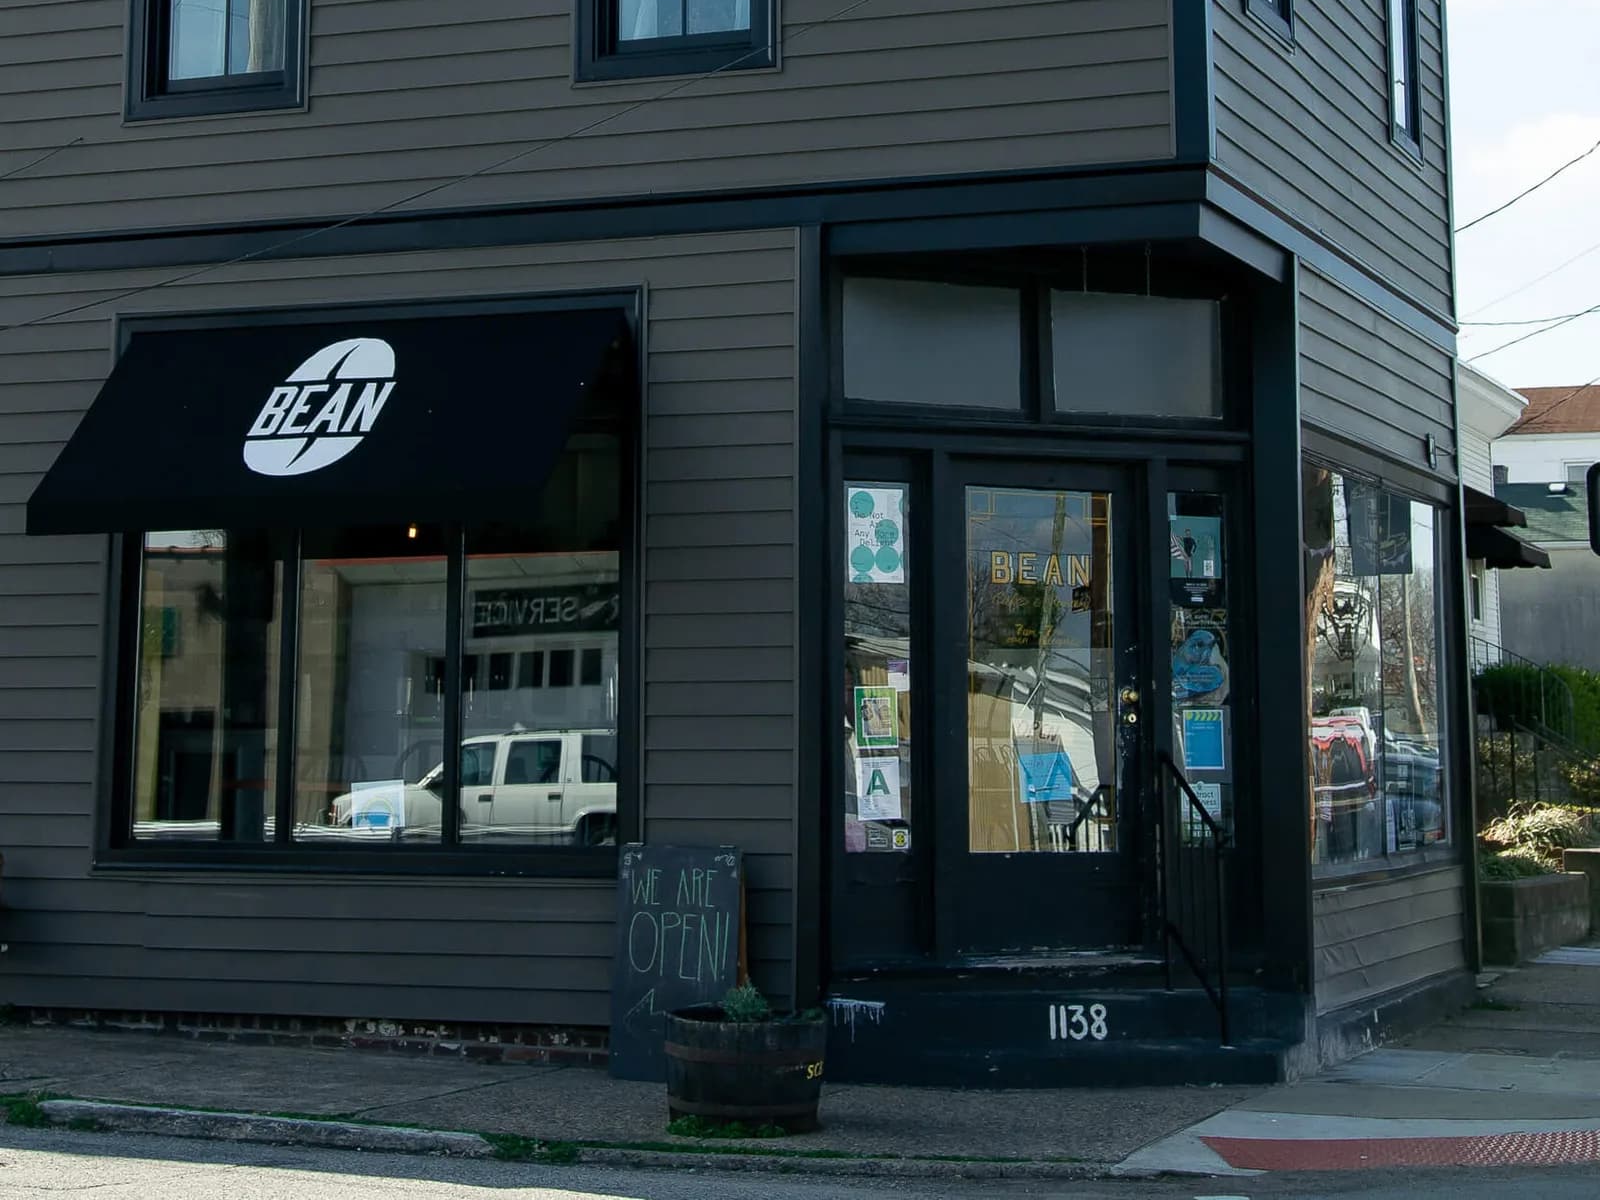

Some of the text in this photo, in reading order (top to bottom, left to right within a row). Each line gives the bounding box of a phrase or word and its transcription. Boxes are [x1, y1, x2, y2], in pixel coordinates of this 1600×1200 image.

[246, 381, 397, 436] BEAN
[854, 529, 870, 538] Any
[870, 511, 884, 519] Not
[990, 550, 1091, 588] BEAN
[866, 768, 891, 795] A
[630, 867, 718, 907] WE ARE
[628, 911, 730, 982] OPEN!
[1049, 1003, 1108, 1040] 1138
